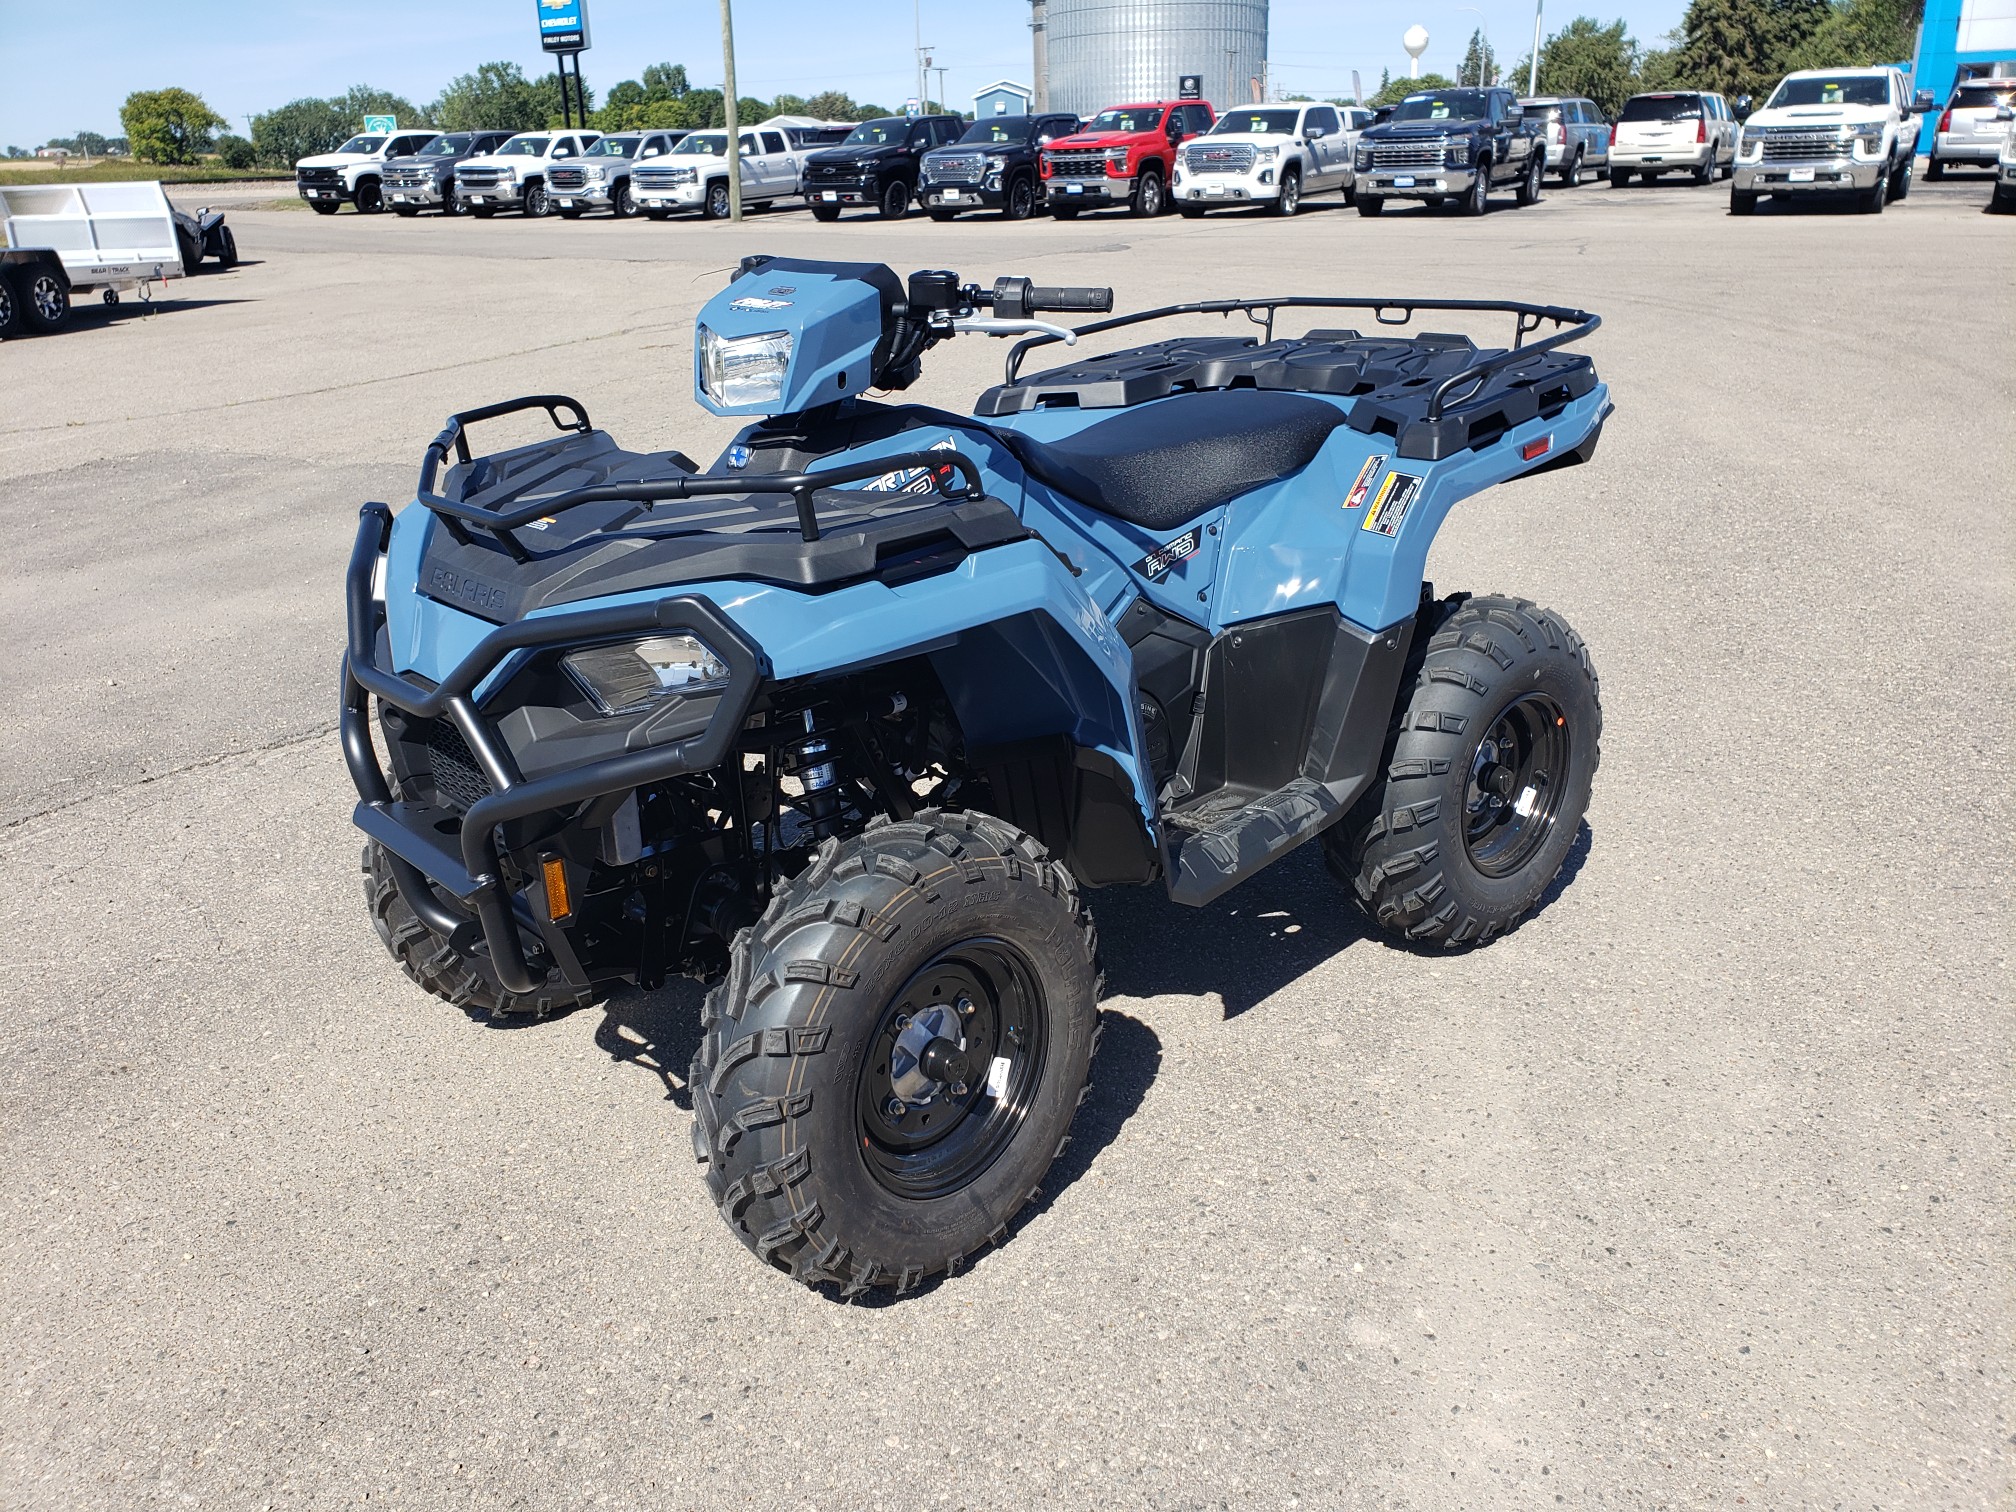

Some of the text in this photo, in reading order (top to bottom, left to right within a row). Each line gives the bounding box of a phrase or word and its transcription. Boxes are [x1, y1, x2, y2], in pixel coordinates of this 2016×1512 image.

[541, 16, 578, 28] CHEVROLET
[1147, 538, 1194, 577] AWD
[430, 567, 507, 609] POLARIS
[1044, 926, 1083, 1050] POLARIS
